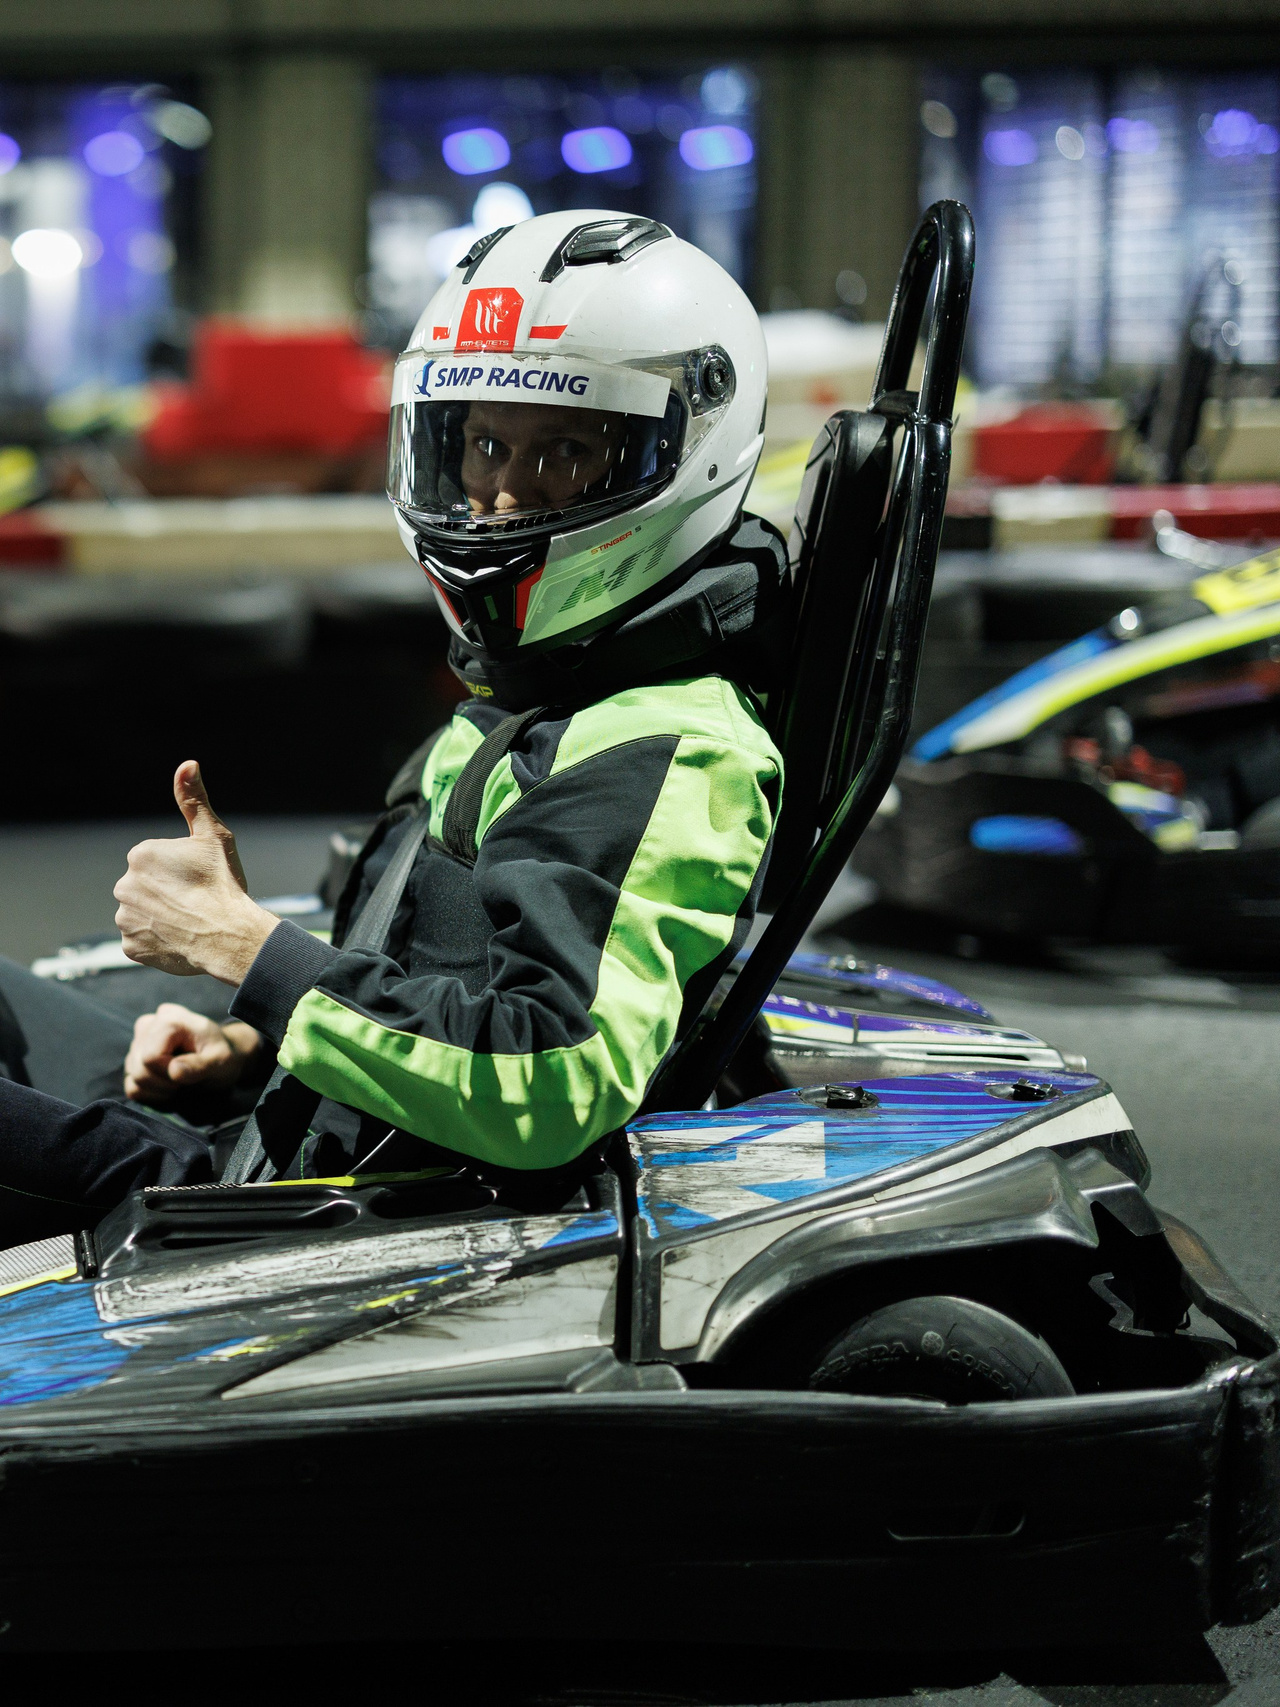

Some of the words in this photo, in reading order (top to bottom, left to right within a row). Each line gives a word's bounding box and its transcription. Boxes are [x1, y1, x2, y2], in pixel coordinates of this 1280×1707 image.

[435, 367, 483, 388] SMP
[486, 367, 590, 396] RACING
[590, 530, 633, 555] STINGER
